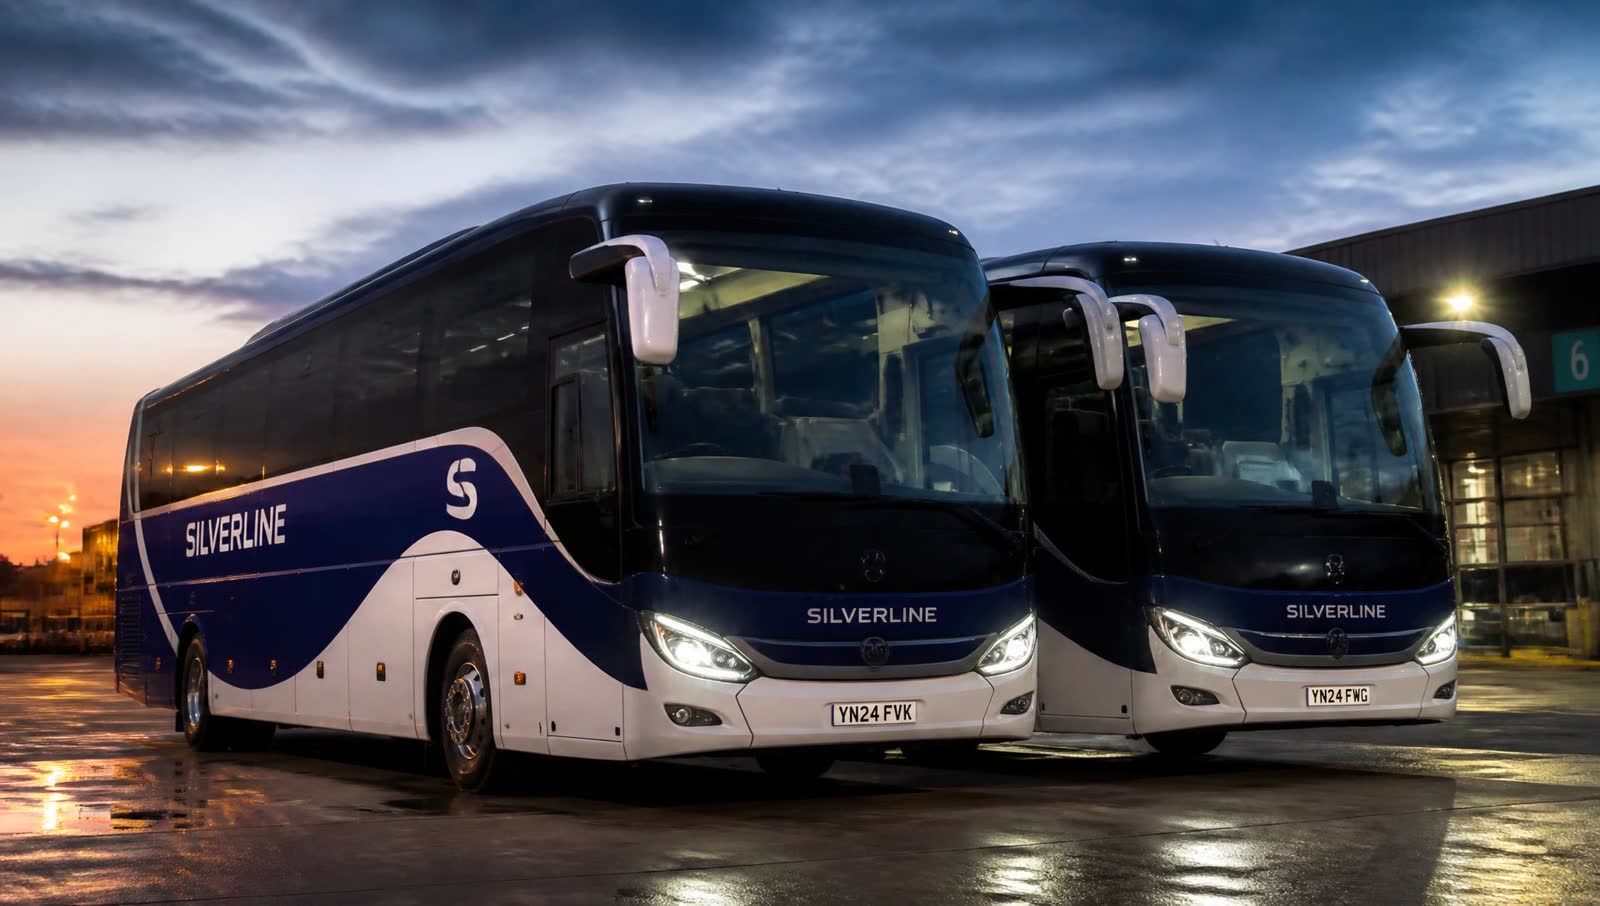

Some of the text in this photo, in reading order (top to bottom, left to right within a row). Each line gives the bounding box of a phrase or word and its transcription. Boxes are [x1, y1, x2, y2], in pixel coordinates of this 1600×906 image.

[1570, 341, 1589, 381] 6
[185, 503, 287, 558] SILVERLINE
[807, 606, 937, 625] SILVERLINE
[1286, 604, 1386, 619] SILVERLINE
[1311, 686, 1368, 704] YN24 FWG
[838, 703, 912, 723] YN24 FVK
